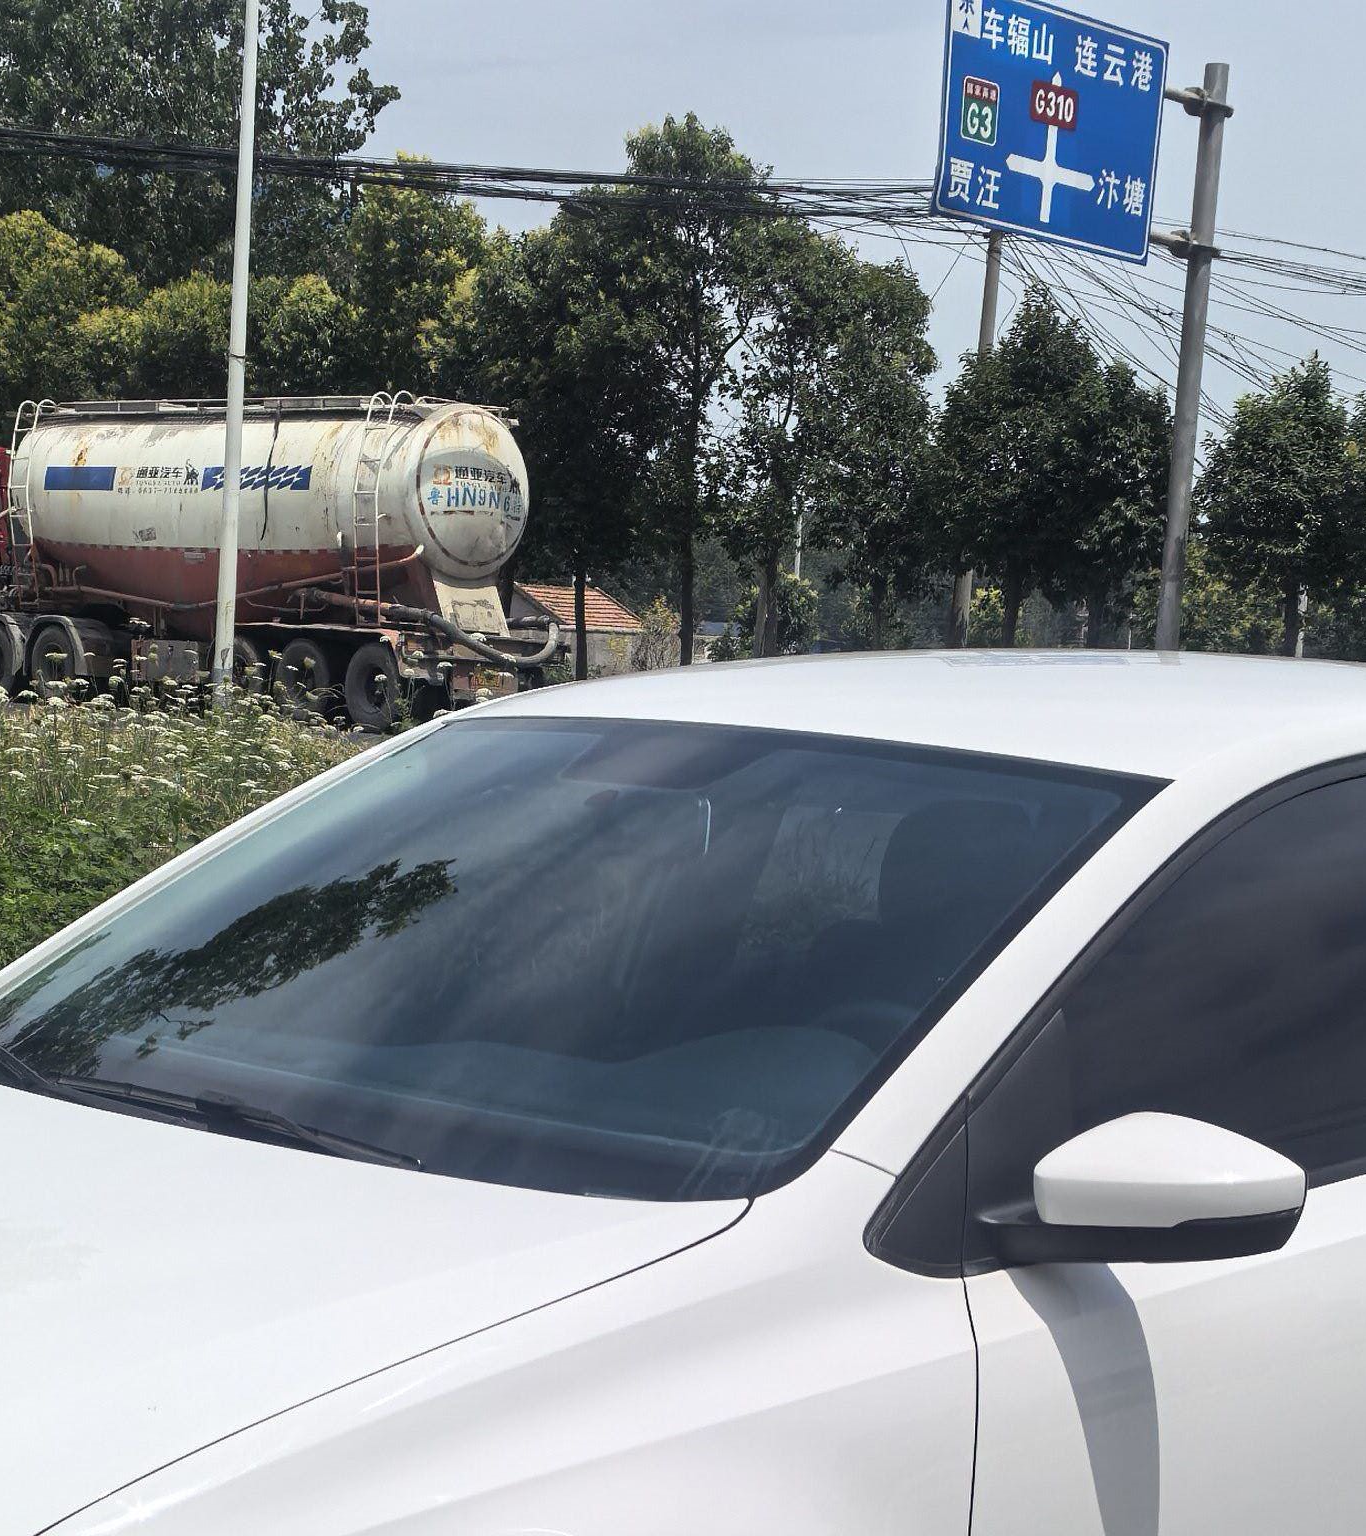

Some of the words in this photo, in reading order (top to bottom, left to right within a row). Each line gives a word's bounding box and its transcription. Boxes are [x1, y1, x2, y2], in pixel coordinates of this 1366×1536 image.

[982, 7, 1054, 65] 车辐山
[1074, 34, 1153, 92] 连云港
[967, 103, 992, 138] G3
[1035, 89, 1074, 123] G310
[947, 157, 1002, 210] 贾汪
[1097, 168, 1146, 217] 汴塘
[136, 466, 184, 479] 通亚汽车
[454, 465, 507, 484] 通亚汽车
